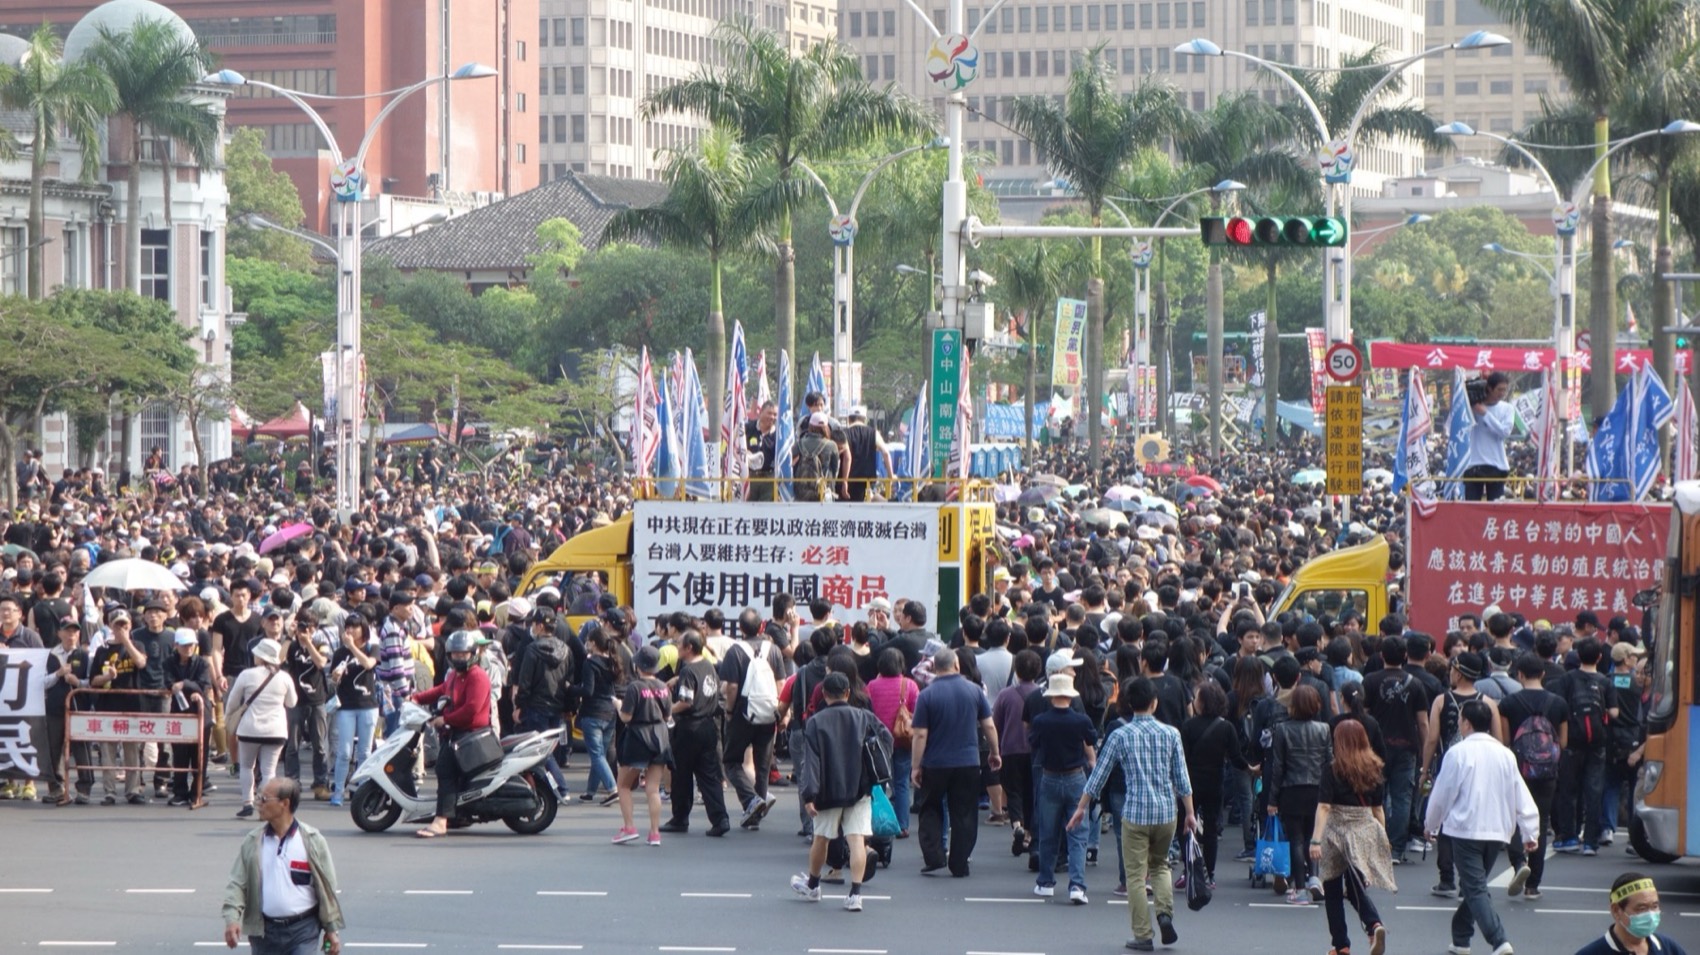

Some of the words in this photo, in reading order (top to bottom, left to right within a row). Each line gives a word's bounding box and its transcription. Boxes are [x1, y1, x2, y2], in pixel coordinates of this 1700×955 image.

[1333, 355, 1355, 369] 50
[939, 357, 953, 440] 中山南路
[1330, 390, 1344, 492] 請依速限行駛
[1346, 390, 1360, 491] 前有測速照相
[647, 515, 927, 540] 中共現在正在要以政治經濟破滅台灣
[648, 571, 888, 610] 不使用中國商品
[1448, 580, 1648, 613] 在進步中華民族主義
[87, 718, 182, 736] 車輛改道
